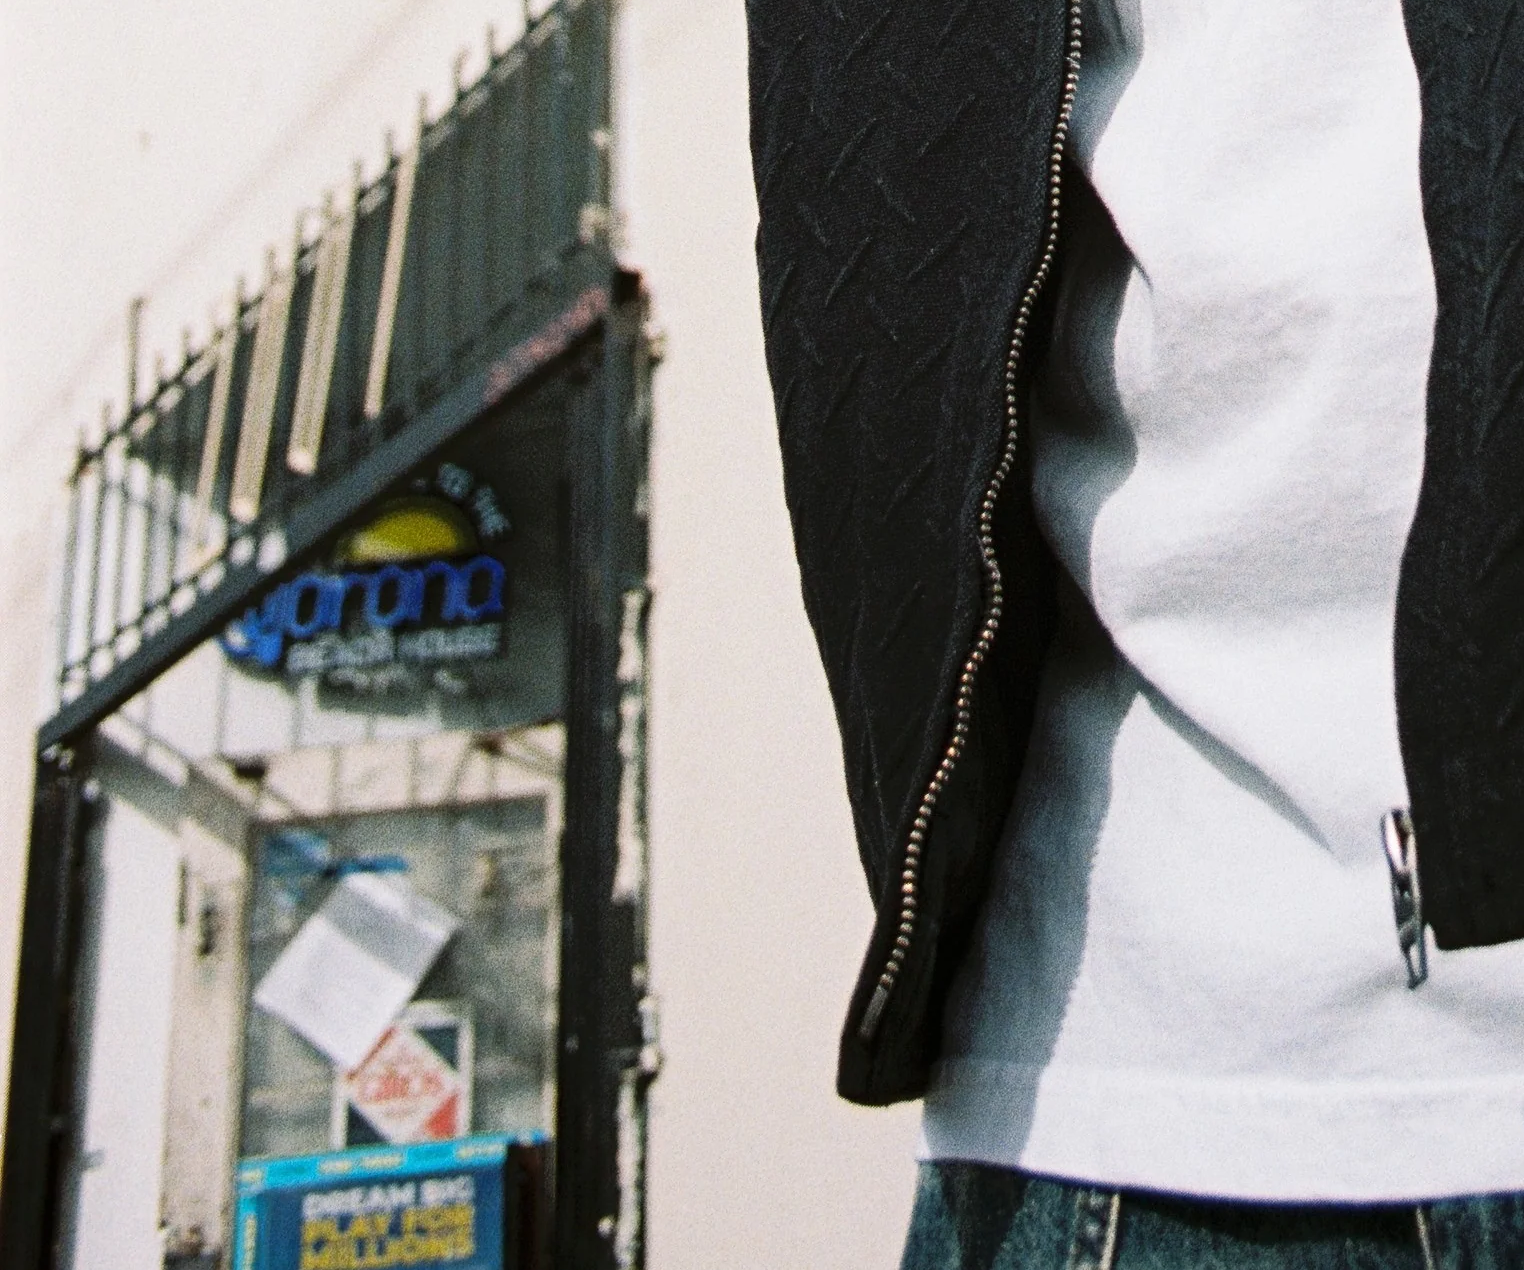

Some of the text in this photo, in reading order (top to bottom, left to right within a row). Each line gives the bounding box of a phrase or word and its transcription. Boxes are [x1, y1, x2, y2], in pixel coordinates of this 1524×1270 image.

[302, 1173, 475, 1219] DREAM BIG
[302, 1203, 476, 1245] PLAY FOR
[301, 1226, 476, 1270] MILLIONS
